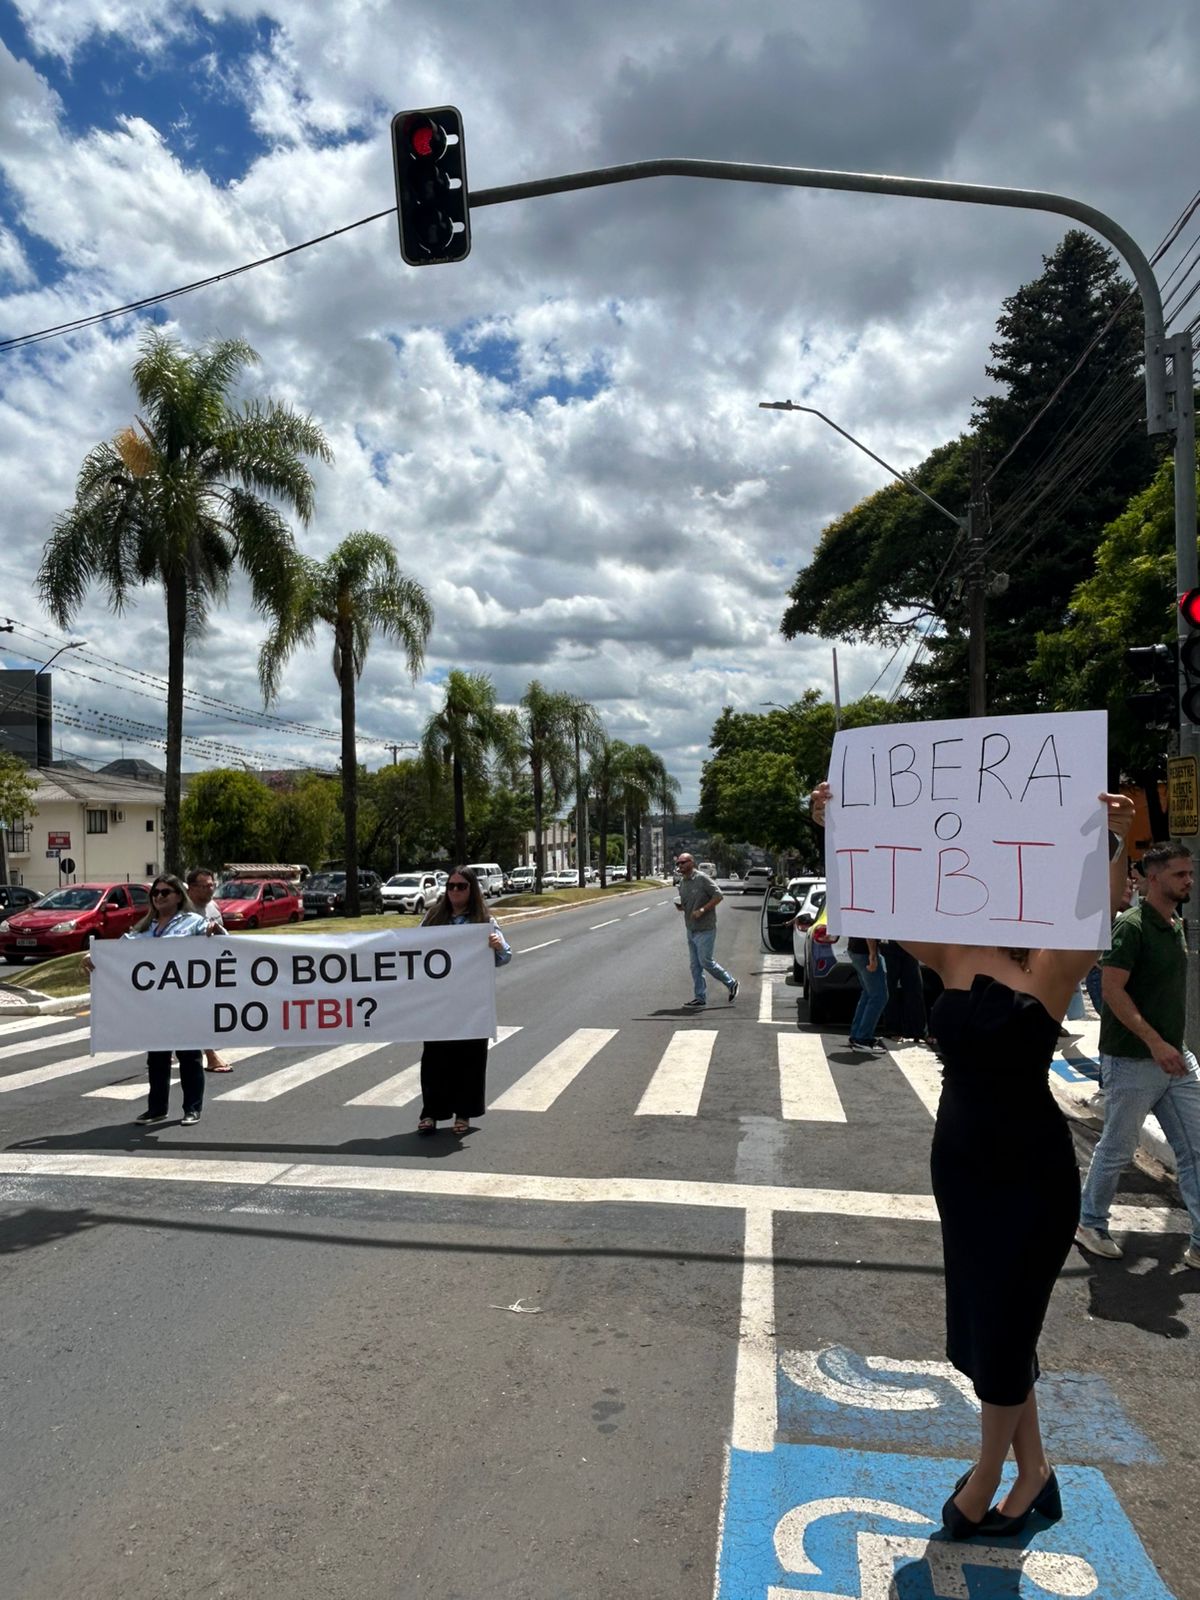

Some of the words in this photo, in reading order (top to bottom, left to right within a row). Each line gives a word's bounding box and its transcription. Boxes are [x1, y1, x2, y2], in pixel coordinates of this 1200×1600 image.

[934, 812, 962, 840] O
[836, 840, 1055, 926] ITBI
[131, 949, 238, 991] CADÊ
[251, 956, 279, 987] O
[292, 948, 452, 985] BOLETO
[213, 1000, 269, 1034] DO
[281, 997, 378, 1031] ITBI?
